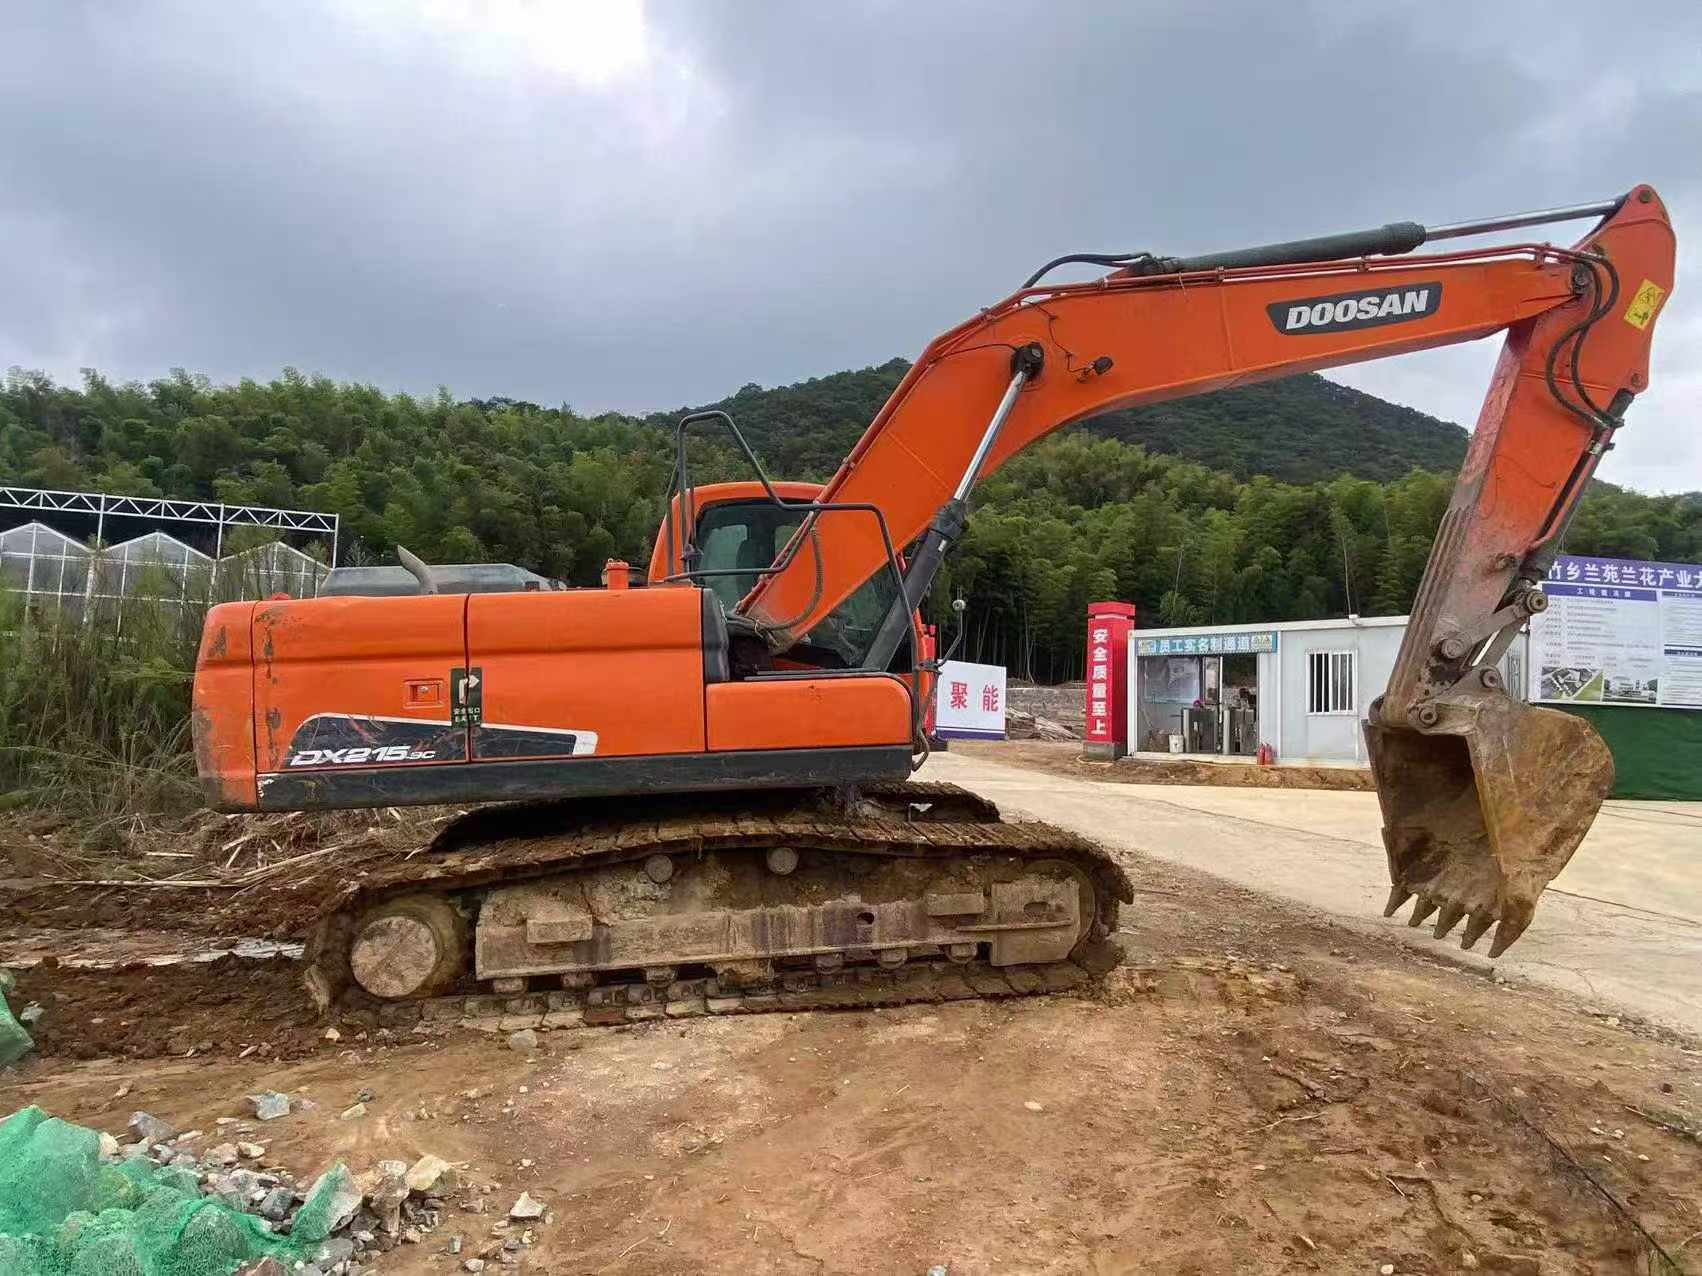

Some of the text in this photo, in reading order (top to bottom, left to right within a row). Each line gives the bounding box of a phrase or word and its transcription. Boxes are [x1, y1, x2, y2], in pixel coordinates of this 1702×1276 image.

[1286, 290, 1428, 330] DOOSAN
[950, 681, 999, 712] 聚能
[1091, 628, 1109, 735] 安全质量至上
